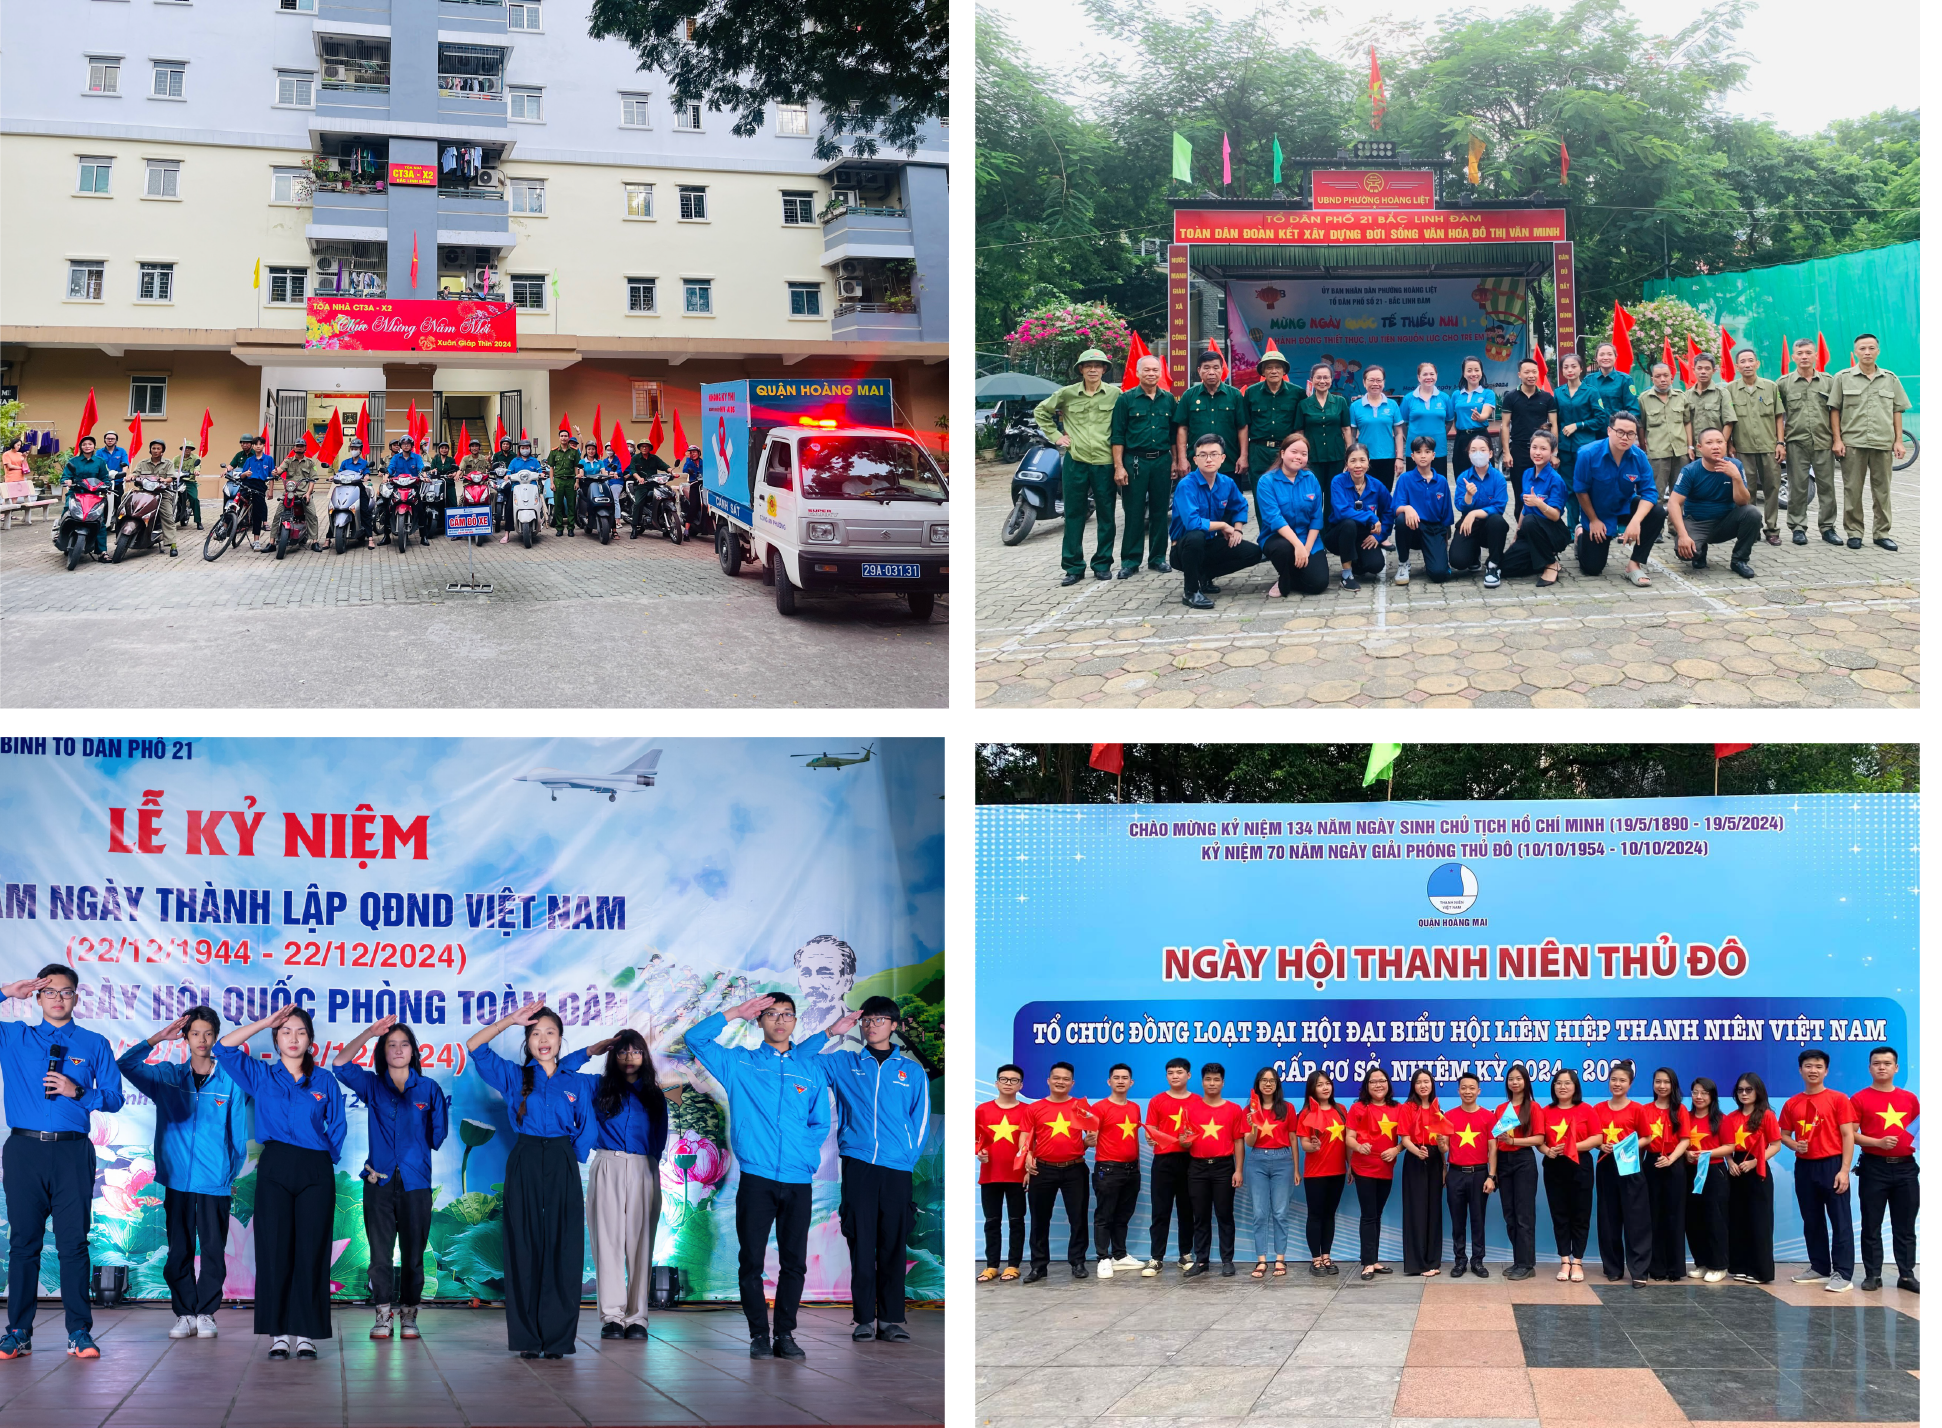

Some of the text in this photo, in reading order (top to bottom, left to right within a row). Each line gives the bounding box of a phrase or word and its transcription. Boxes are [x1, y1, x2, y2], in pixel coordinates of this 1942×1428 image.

[393, 169, 433, 179] CT3A X2
[1344, 195, 1380, 204] PHƯỜNG
[1381, 195, 1411, 204] HOÀNG
[1413, 195, 1430, 205] LIỆT
[1266, 212, 1284, 223] TỔ
[1290, 214, 1321, 223] DÂN
[1326, 213, 1354, 223] PHỐ
[1378, 212, 1408, 223] BẮC
[1449, 214, 1481, 222] ĐÀM
[1180, 226, 1210, 239] TOÀN
[1215, 227, 1238, 239] DÂN
[1243, 225, 1274, 239] ĐOÀN
[1279, 226, 1299, 239] KẾT
[1304, 228, 1325, 239] XÂY
[1330, 228, 1361, 241] DỰNG
[1366, 226, 1385, 239] ĐỜI
[1391, 225, 1419, 239] SỐNG
[1424, 227, 1448, 238] VĂN
[1472, 226, 1486, 238] ĐÔ
[1490, 228, 1506, 239] THỊ
[1509, 226, 1529, 237] VĂN
[1533, 227, 1560, 237] MINH
[313, 302, 330, 310] TÒA
[335, 314, 491, 340] Chúc Mừng Năm Mới
[1270, 317, 1306, 329] MỪNG
[1310, 315, 1341, 330] NGÀY
[1381, 312, 1397, 328] TẾ
[1401, 312, 1435, 328] THIẾU
[1439, 315, 1458, 328] NHI
[1274, 336, 1296, 345] HÀNH
[1298, 335, 1322, 346] ĐỘNG
[1324, 334, 1343, 344] THIẾT
[1381, 334, 1395, 343] TIÊN
[756, 382, 884, 398] QUẬN HOÀNG MAI
[716, 495, 740, 517] CẢNH SÁT
[449, 514, 466, 527] CẤM
[478, 516, 488, 525] XE
[864, 565, 917, 576] 29A-031.31
[172, 741, 192, 760] 21
[108, 789, 430, 869] LỄ KỶ NIỆM
[1129, 814, 1785, 838] CHÀO MỪNG KỶ NIỆM 134 NĂM NGÀY SINH CHỦ TỊCH HỒ CHÍ MINH (19/5/1890 19/5/2024)
[1201, 839, 1708, 862] KỶ NIỆM 70 NĂM NGÀY GIẢI PHÓNG THỦ ĐÔ (10/10/1954 10/10/2024)
[0, 878, 626, 937] M NGÀY THÀNH LẬP QĐND VIỆT NAM
[1418, 918, 1440, 928] QUẬN
[1443, 917, 1470, 926] HOÀNG
[66, 936, 467, 975] (22/12/1944 22/12/2024)
[1164, 934, 1747, 988] NGÀY HỘI THANH NIÊN THỦ ĐÔ
[72, 977, 141, 1019] GÀY
[222, 974, 316, 1026] QUỐC
[328, 980, 446, 1025] PHÒNG
[458, 983, 546, 1025] TOÀN
[559, 984, 628, 1026] DÂN
[1033, 1011, 1887, 1048] TỔ CHỨC ĐỒNG LOẠT ĐẠI HỘI ĐẠI BIỂU HỘI LIÊN HIỆP THANH NIÊN VIỆT NAM
[1273, 1051, 1317, 1082] CẤP
[1322, 1059, 1349, 1082] CƠ
[1474, 1052, 1508, 1082] KỲ
